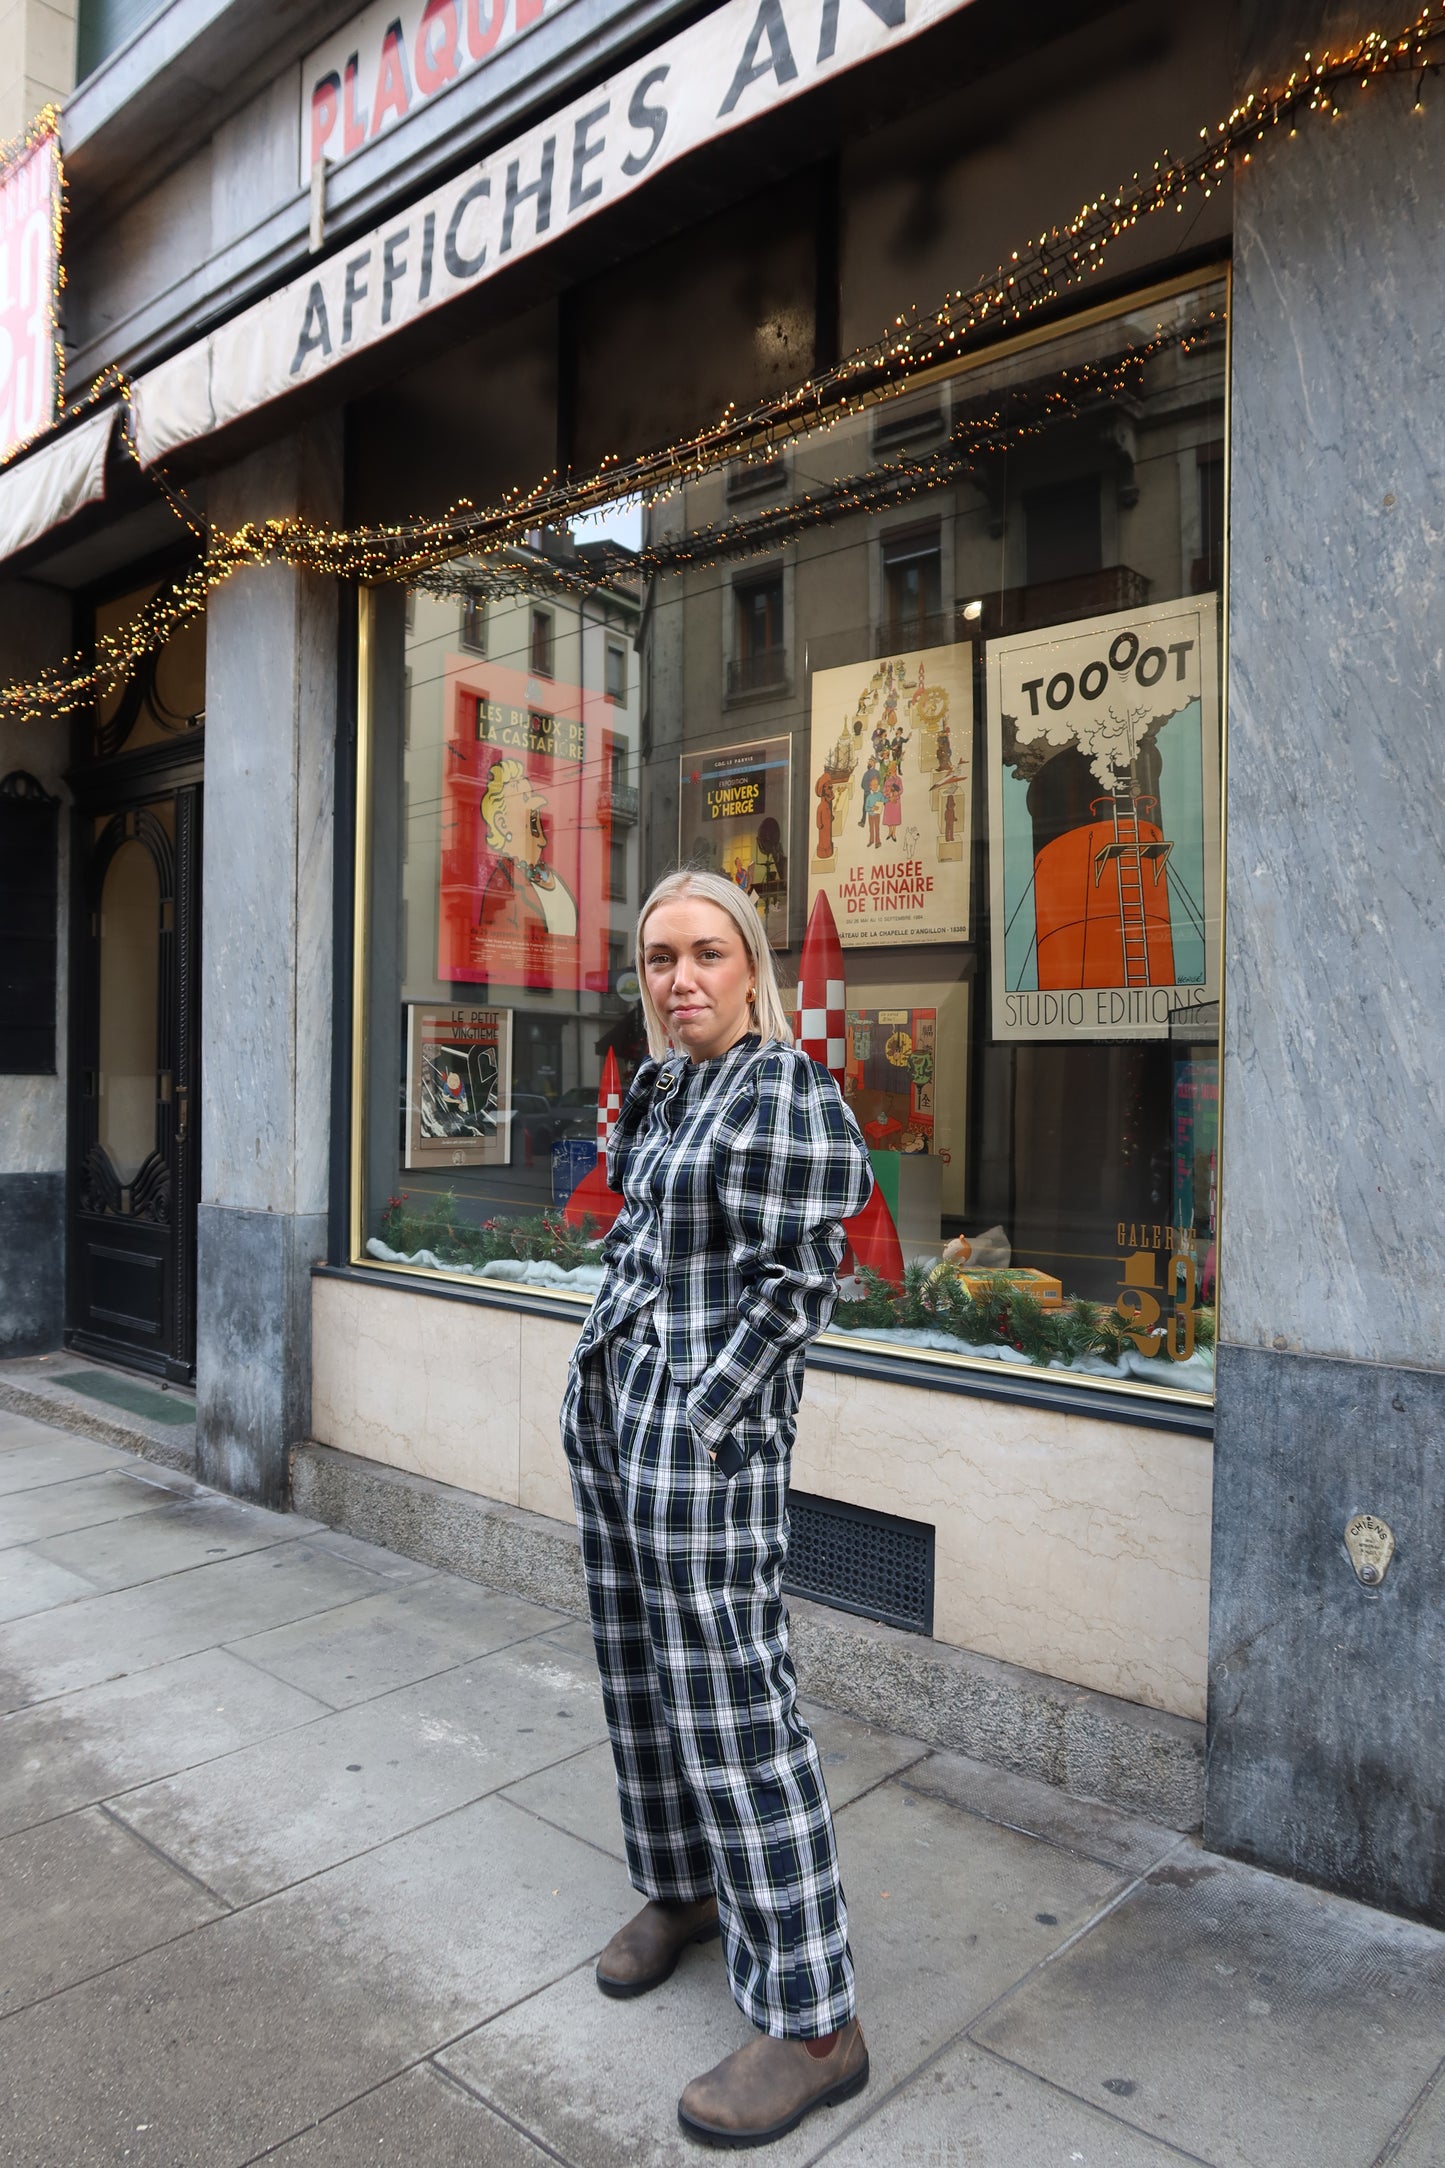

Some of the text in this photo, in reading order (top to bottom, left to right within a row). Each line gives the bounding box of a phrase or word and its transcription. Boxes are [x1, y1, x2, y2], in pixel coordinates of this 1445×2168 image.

[290, 64, 671, 376] AFFICHES
[1021, 631, 1195, 716] TOOOOT
[479, 722, 498, 741] LA
[480, 702, 585, 742] LES BIJOUX DE
[707, 783, 760, 805] L'UNIVERS
[849, 860, 923, 882] LE MUSÉE
[838, 876, 935, 899] IMAGINAIRE
[846, 893, 925, 914] DE TINTIN
[883, 915, 911, 923] SEPTEMBRE
[869, 930, 878, 938] LA
[879, 929, 908, 937] CHAPELLE
[451, 1010, 500, 1024] LE PETIT
[1005, 992, 1084, 1027] STUDIO
[1117, 1222, 1197, 1251] GALERIE
[1350, 1521, 1388, 1541] CHIENS
